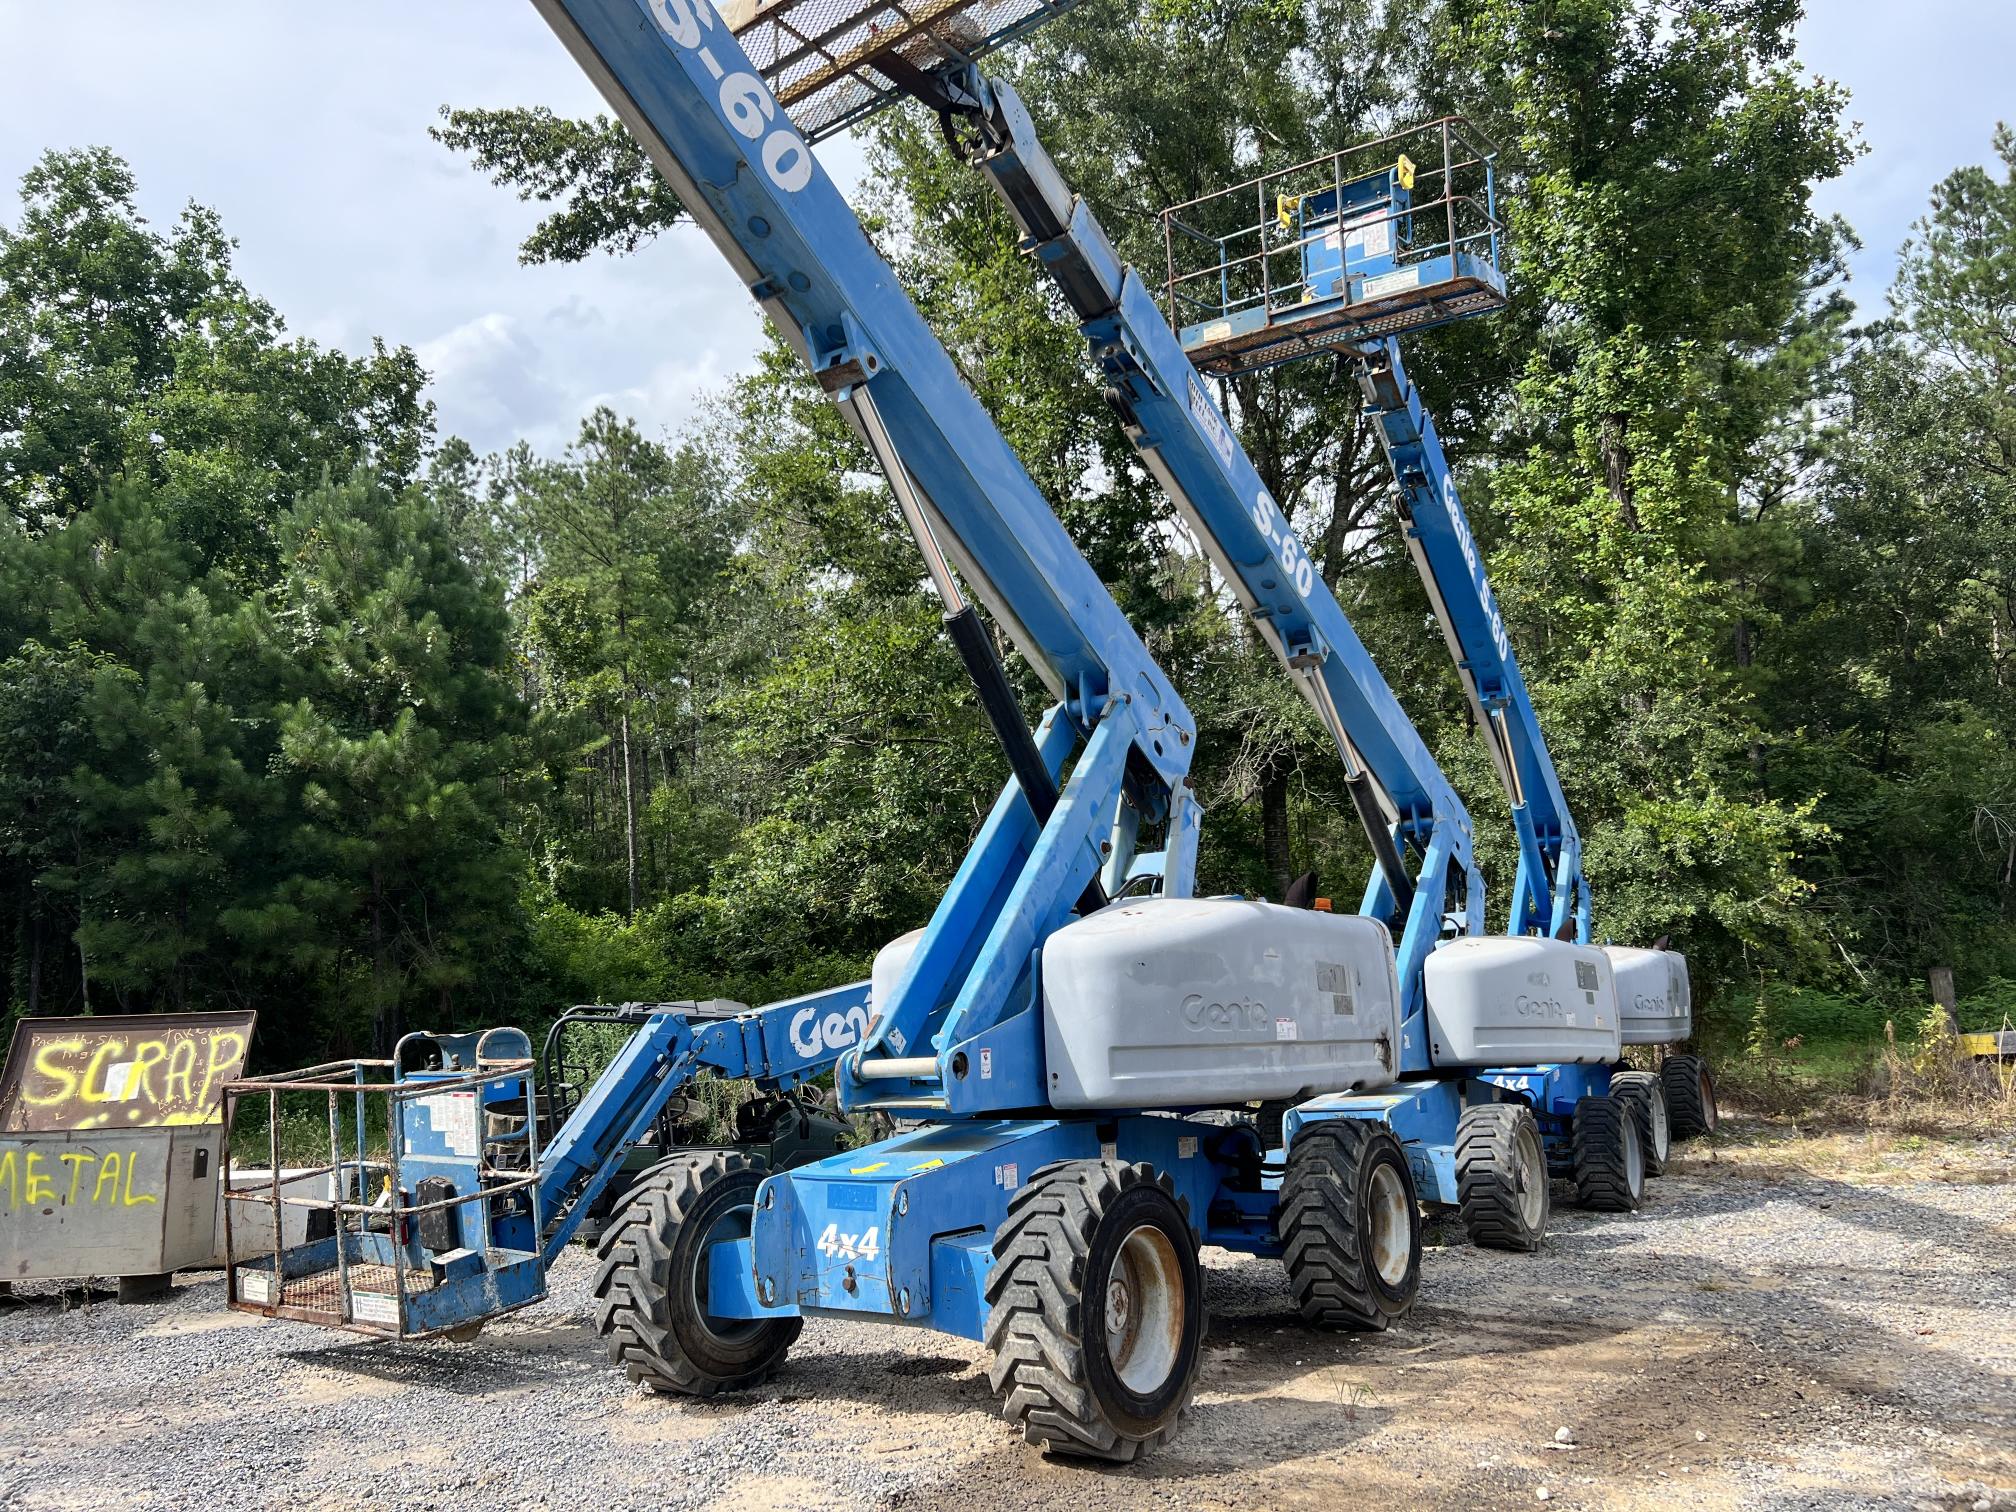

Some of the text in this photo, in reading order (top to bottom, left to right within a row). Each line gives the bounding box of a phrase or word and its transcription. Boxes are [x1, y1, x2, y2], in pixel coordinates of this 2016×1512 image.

[647, 0, 812, 193] S-60
[1252, 491, 1313, 598] S-60
[1443, 474, 1507, 662] Genie S-60
[22, 1033, 244, 1109] SCRAP
[1493, 1075, 1529, 1091] 4x4
[817, 1223, 880, 1262] 4x4
